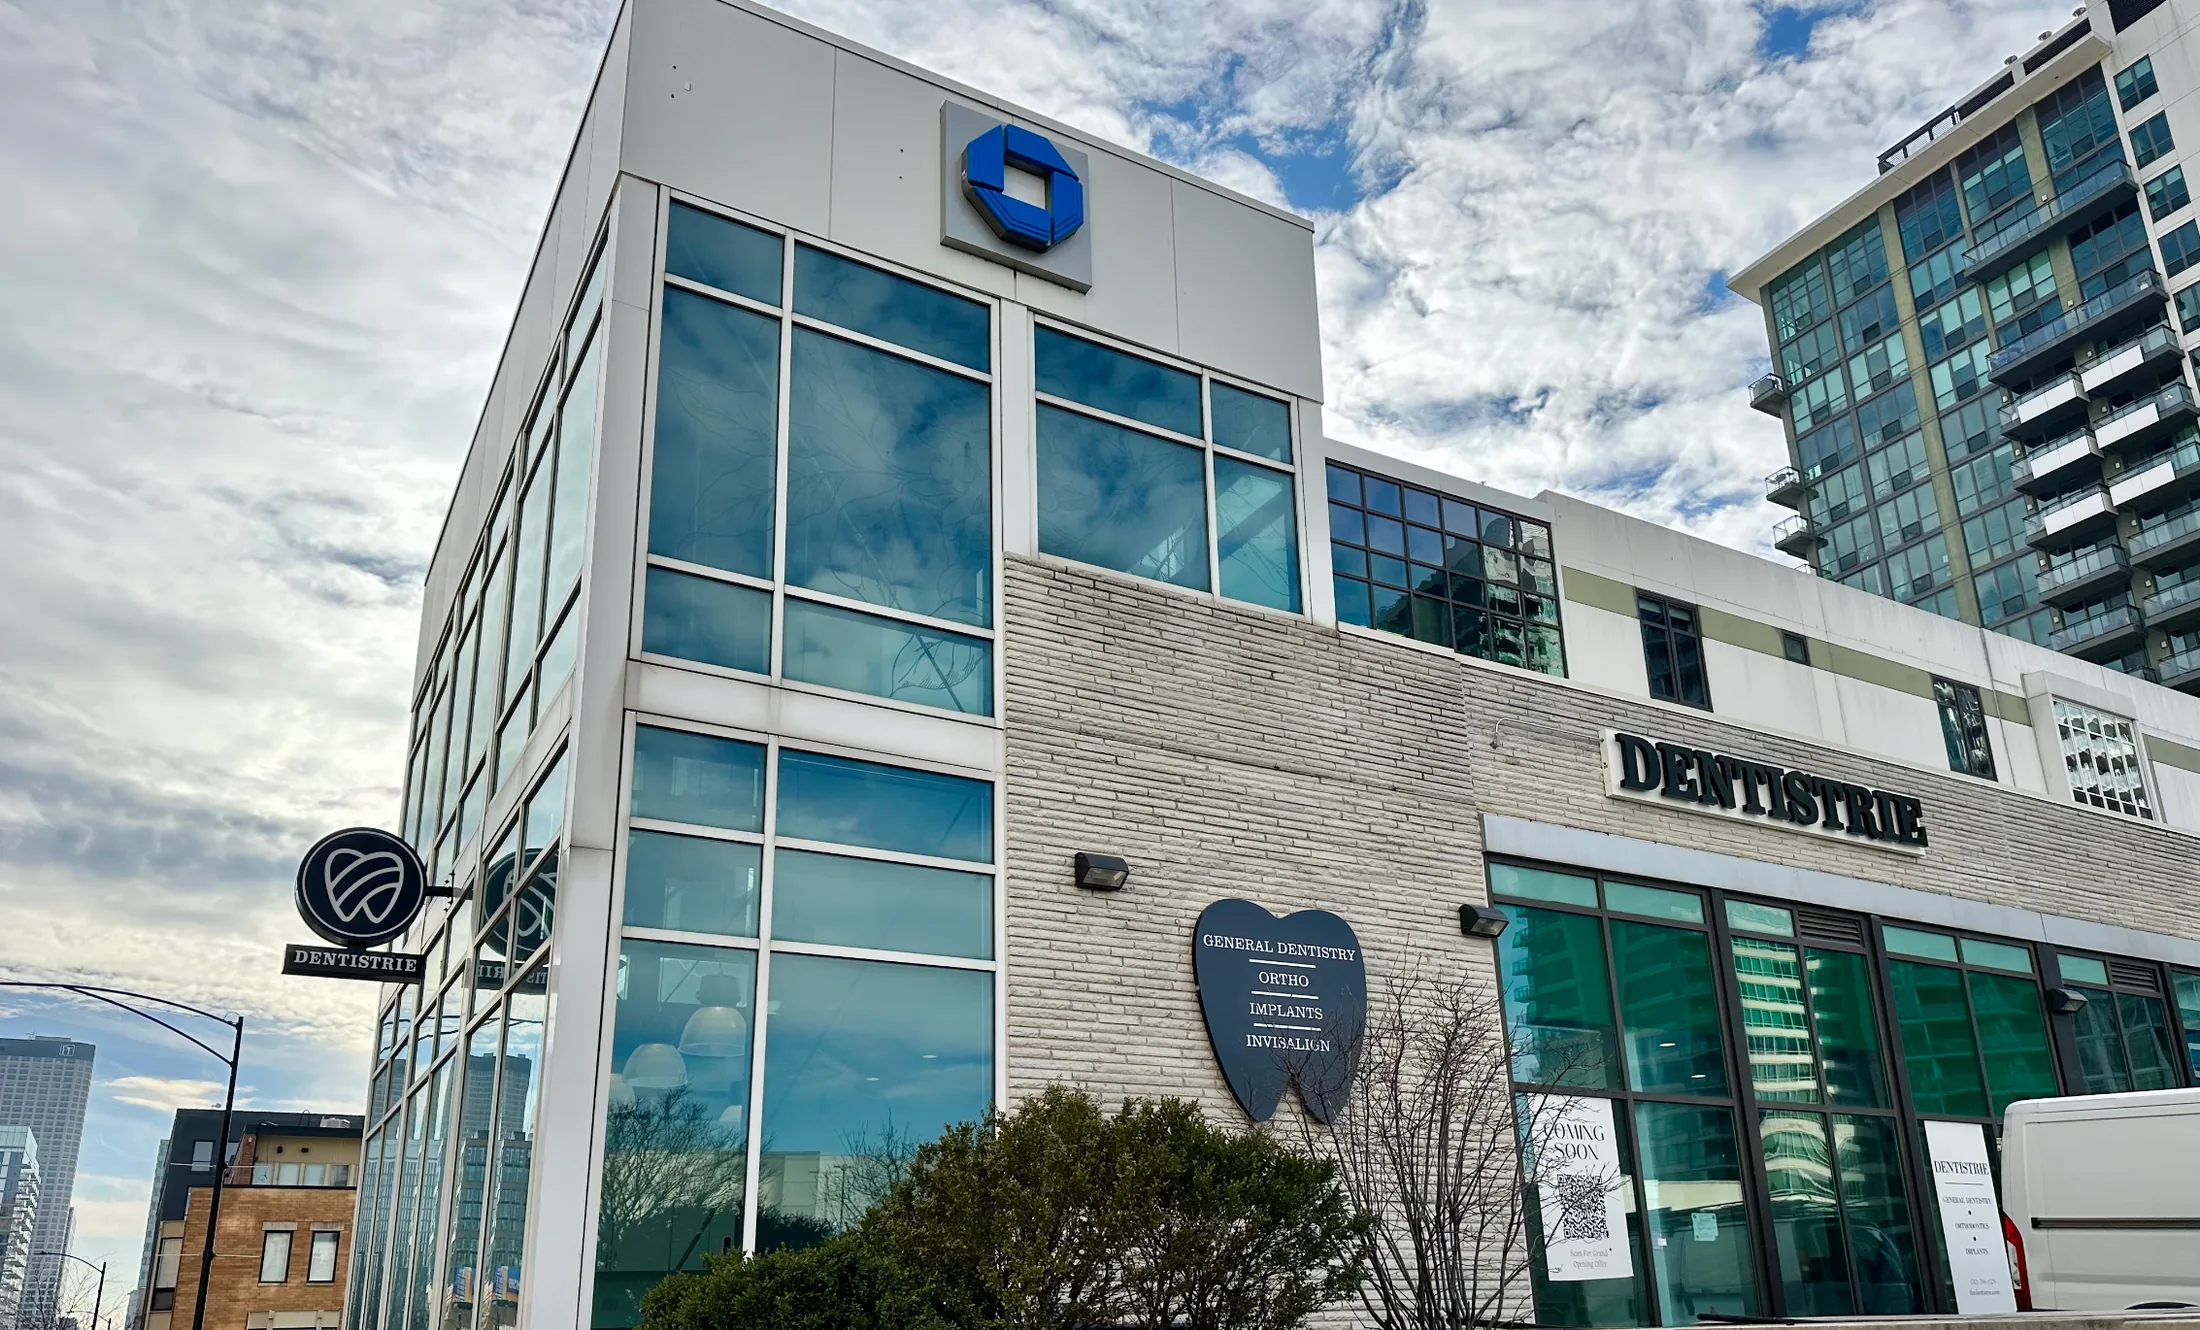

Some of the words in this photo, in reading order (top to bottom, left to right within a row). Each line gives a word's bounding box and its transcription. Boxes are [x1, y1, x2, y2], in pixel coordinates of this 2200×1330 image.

[1615, 733, 1928, 847] DENTISTRIE
[1203, 934, 1273, 953] GENERAL
[1277, 942, 1355, 961] DENTISTRY
[294, 950, 417, 972] DENTISTRIE
[1258, 971, 1309, 987] ORTHO
[1249, 1002, 1323, 1020] IMPLANTS
[1246, 1034, 1330, 1052] INVISALIGN
[1544, 1122, 1604, 1141] COMING
[1554, 1143, 1599, 1160] SOON
[1934, 1160, 1990, 1175] DENTISTRIE
[1942, 1196, 1965, 1204] GENERAL
